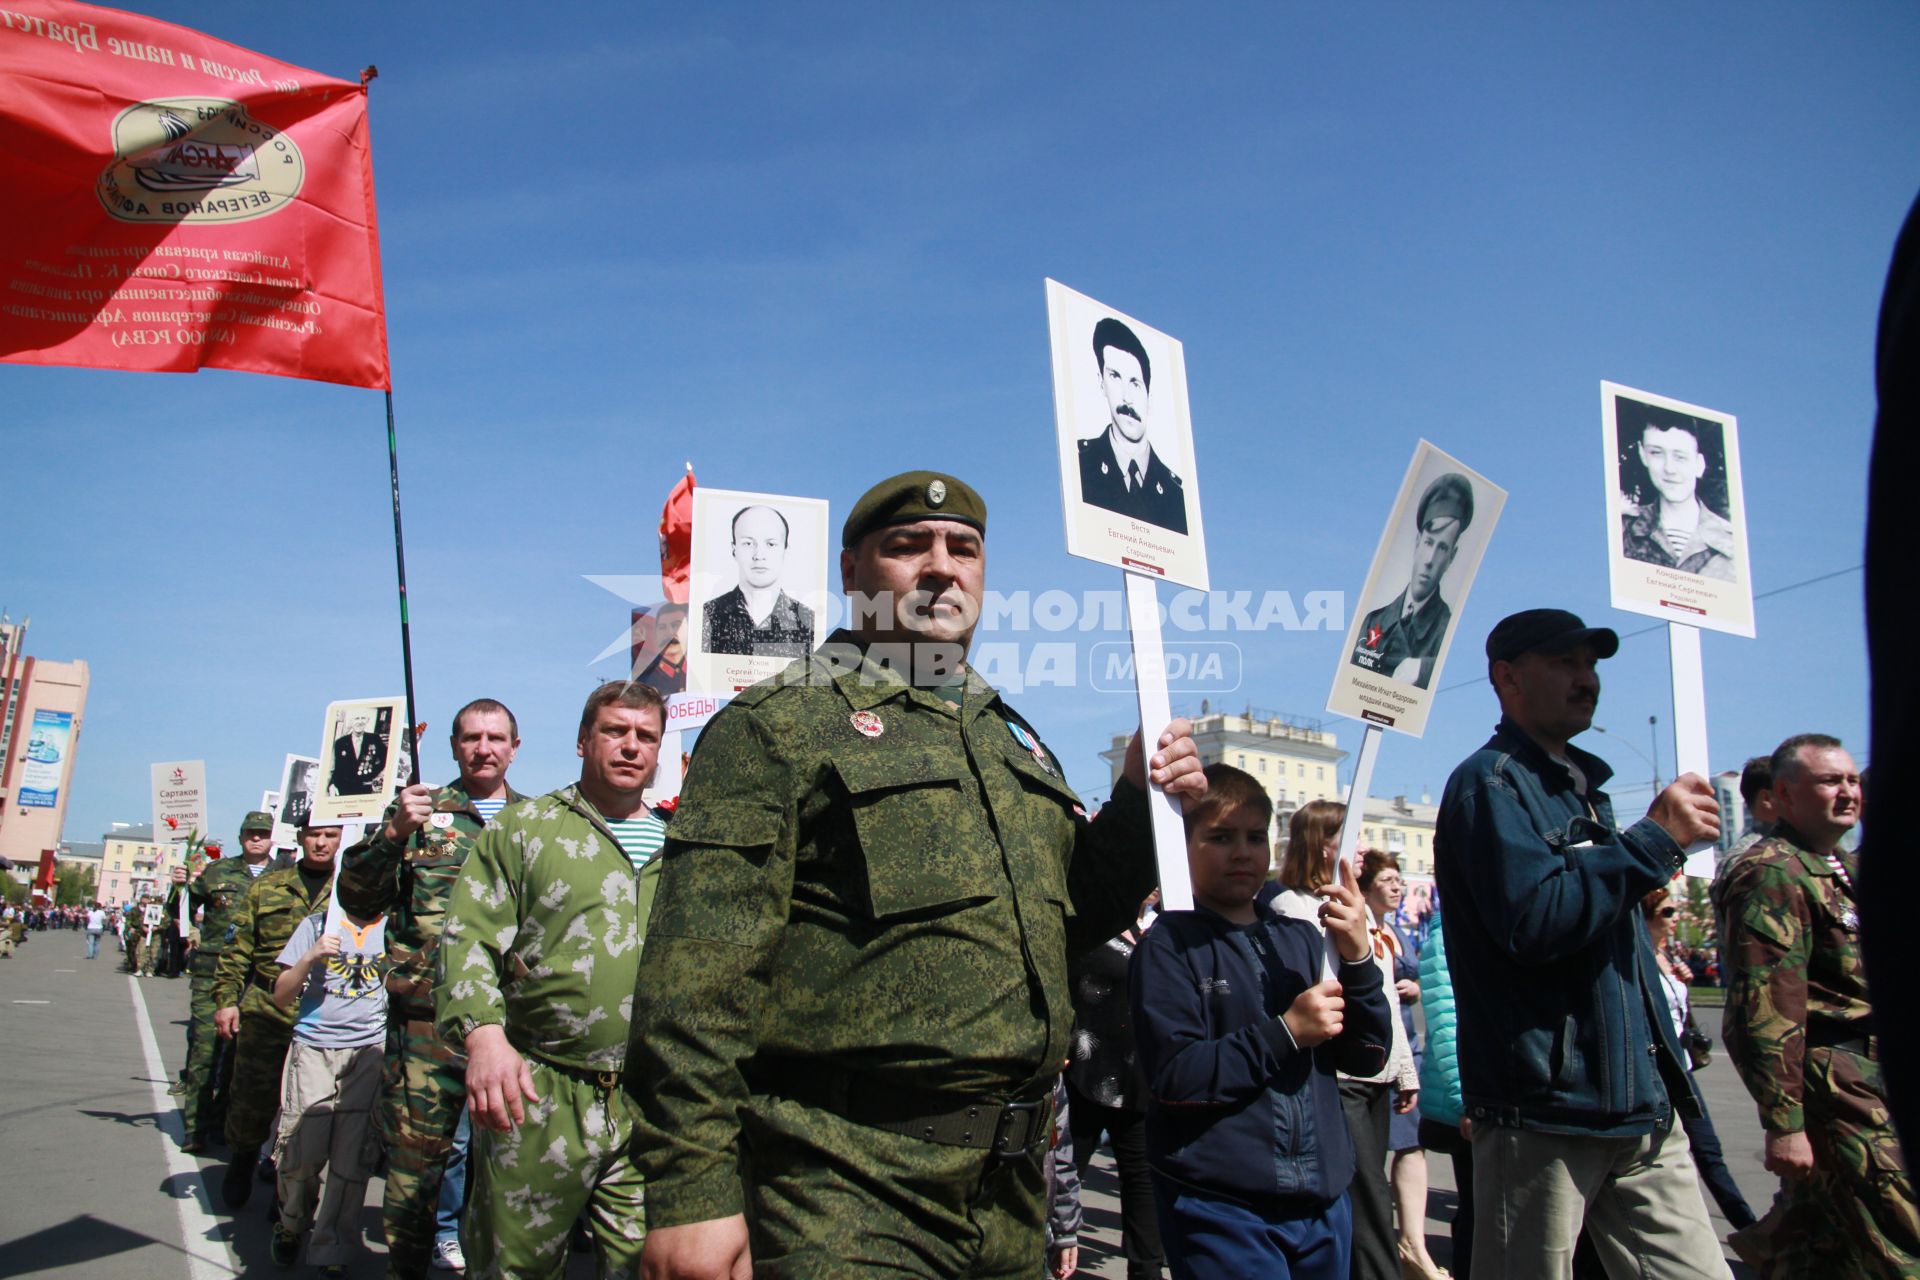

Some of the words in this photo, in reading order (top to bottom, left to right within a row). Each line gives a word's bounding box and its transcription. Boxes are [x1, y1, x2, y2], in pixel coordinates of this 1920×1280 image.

[1107, 527, 1138, 544] Евгений
[1138, 537, 1175, 556] Ананьевич
[726, 667, 752, 676] Сергей
[160, 789, 199, 798] Сартаков
